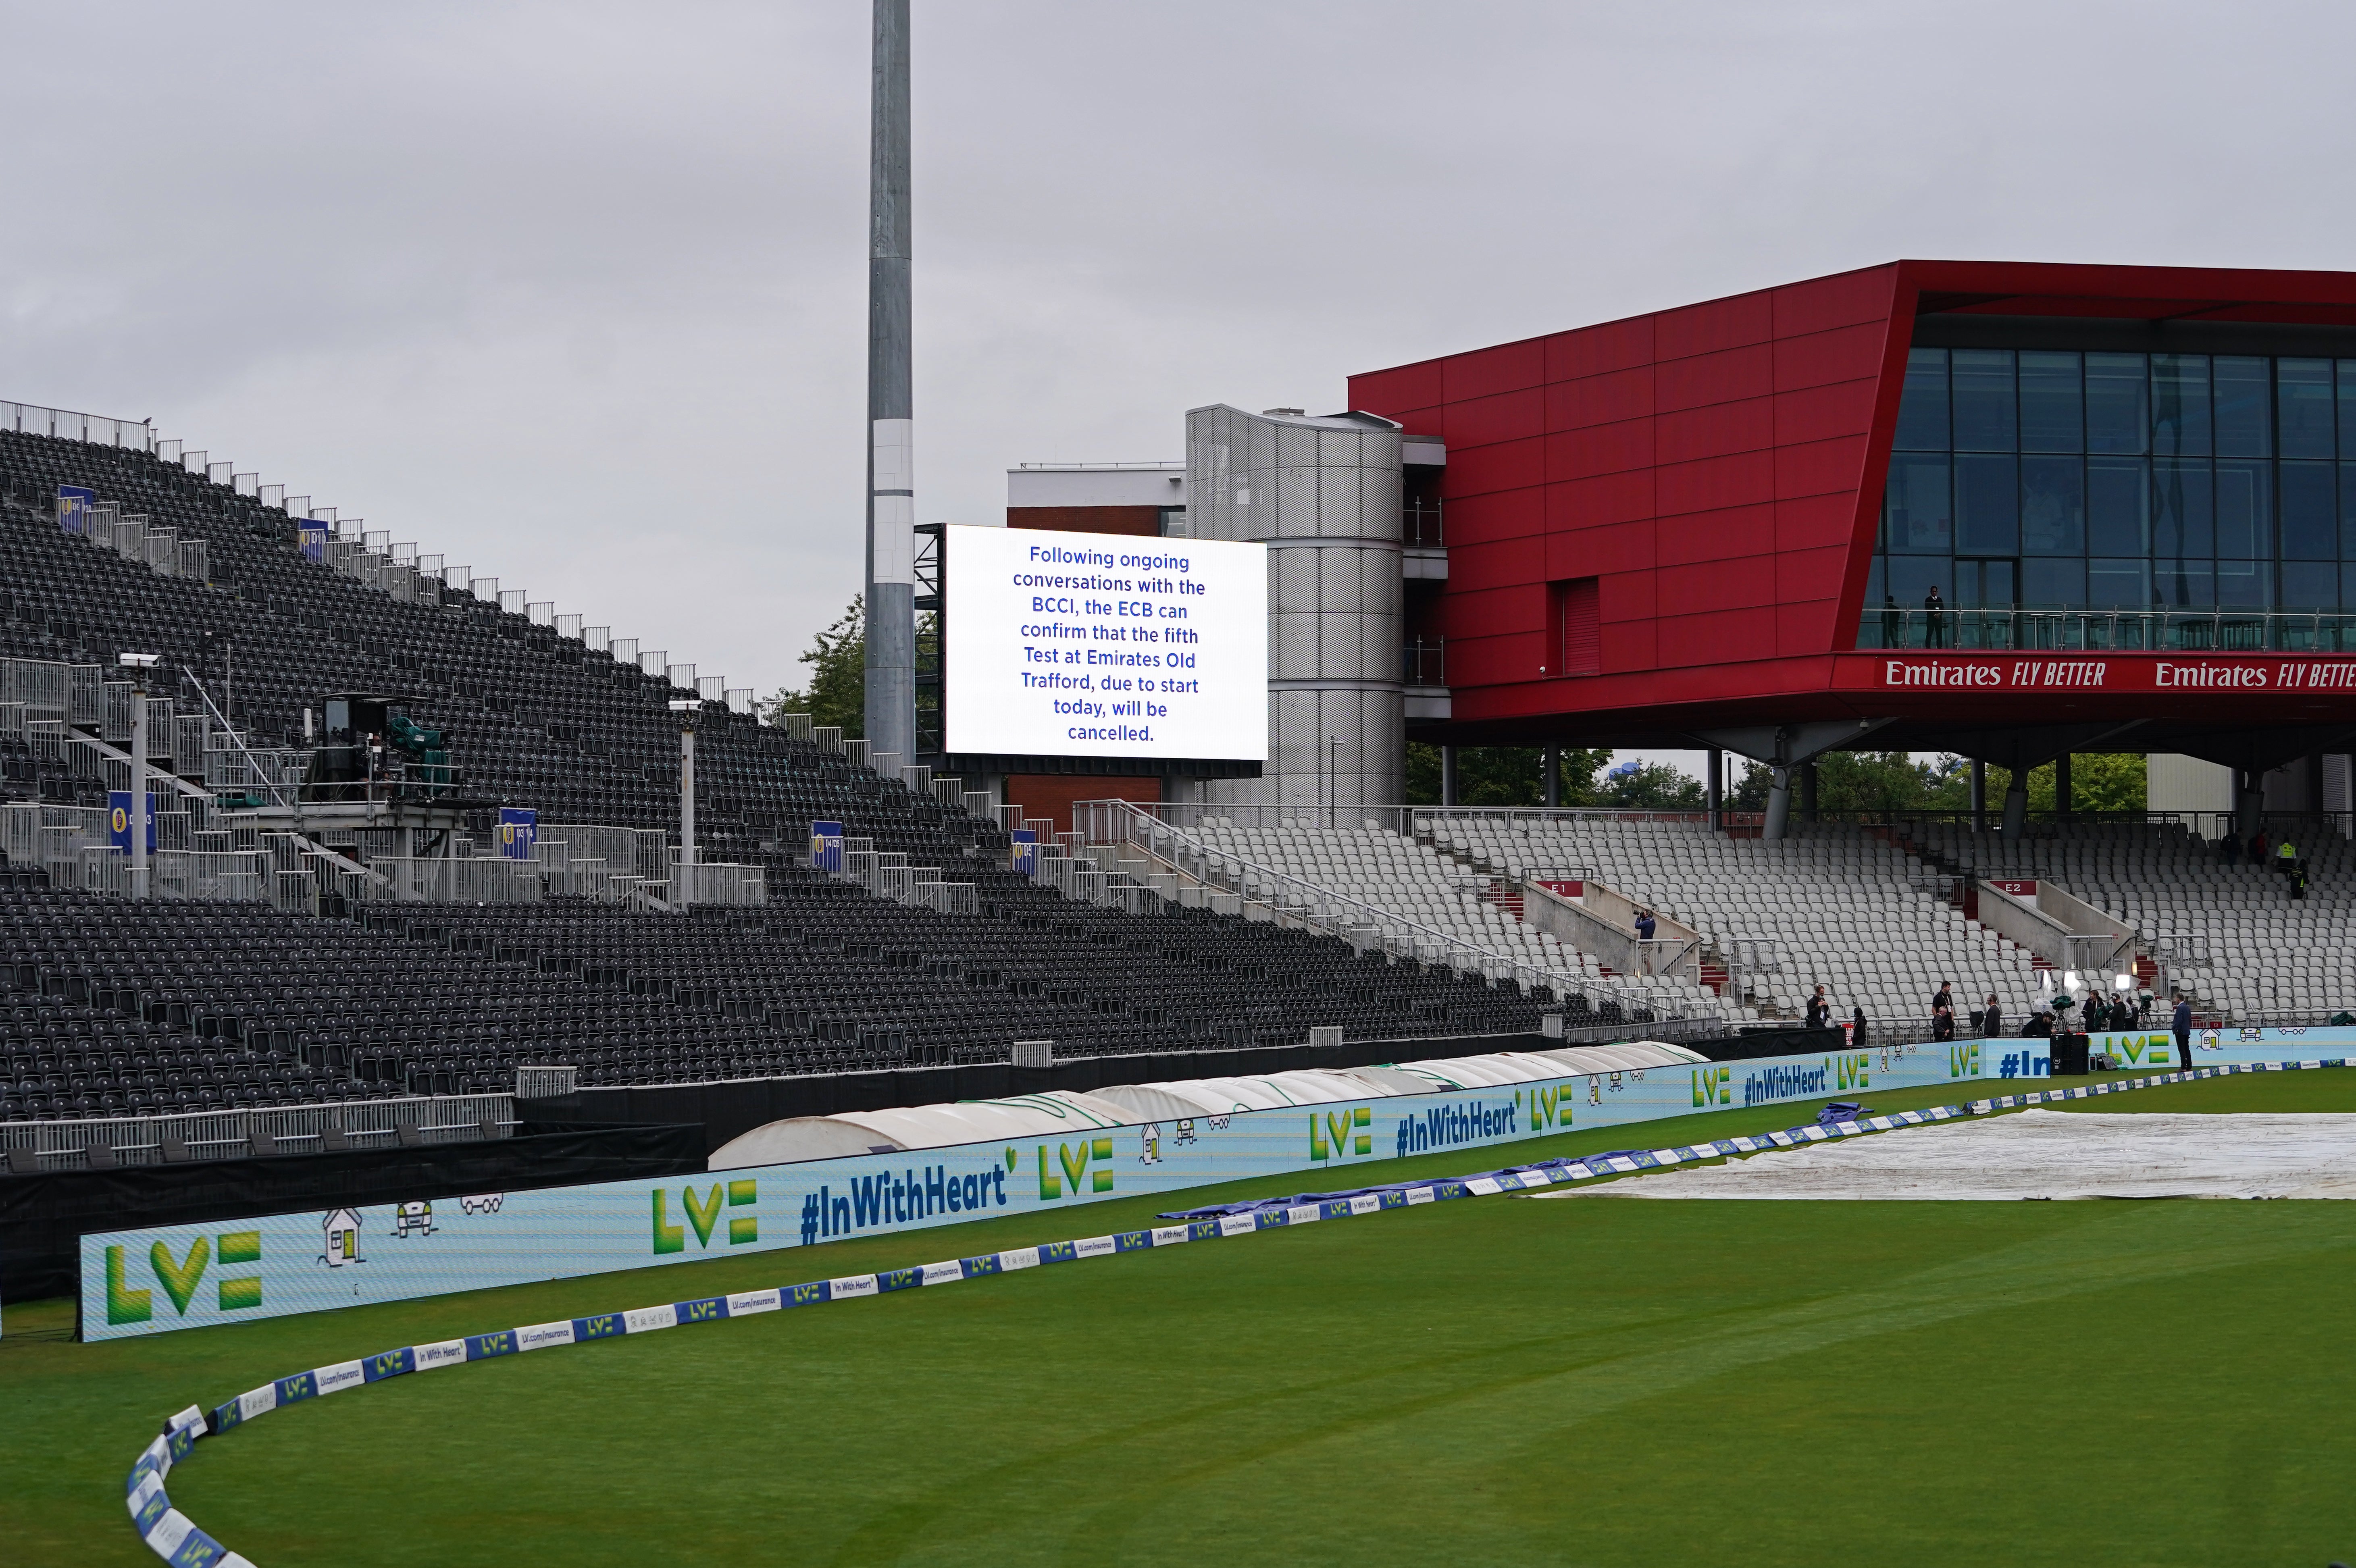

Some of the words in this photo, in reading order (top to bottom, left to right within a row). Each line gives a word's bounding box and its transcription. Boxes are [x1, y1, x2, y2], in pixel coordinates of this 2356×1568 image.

[1031, 547, 1113, 568] Following
[1120, 554, 1188, 572] ongoing
[1014, 574, 1131, 591] conversations
[1138, 578, 1172, 593] with
[1179, 579, 1205, 595] the
[1033, 597, 1078, 616] BCCI,
[1085, 599, 1111, 615] the
[1119, 601, 1153, 617] ECB
[1159, 607, 1186, 618] can
[1021, 623, 1086, 638] confirm
[1093, 625, 1126, 641] that
[1132, 627, 1158, 642] the
[1165, 628, 1197, 643] fifth
[1024, 647, 1058, 663] Test
[1065, 650, 1080, 663] at
[1088, 650, 1160, 667] Emirates
[1167, 653, 1195, 668] Old
[1022, 672, 1094, 692] Trafford,
[1101, 675, 1132, 690] due
[1138, 678, 1154, 691] to
[1161, 679, 1198, 693] start
[1887, 661, 2000, 685] Emirates
[2012, 663, 2041, 685] FLY
[2044, 663, 2105, 685] BETTER
[2156, 663, 2266, 686] Emirates
[2277, 664, 2306, 686] FLY
[1054, 699, 1105, 718] today,
[1112, 701, 1140, 715] will
[1147, 701, 1167, 717] be
[1068, 725, 1153, 741] cancelled.
[1745, 1065, 1825, 1107] #InWithHeart
[1397, 1102, 1515, 1158] #InWithHeart
[801, 1163, 1006, 1246] #InWithHeart
[1224, 1221, 1252, 1231] LV.com/insurance
[1078, 1242, 1111, 1252] LV.com/insurance
[924, 1267, 958, 1279] LV.com/insurance
[732, 1297, 776, 1310] LV.com/insurance
[522, 1329, 569, 1343] LV.com/insurance
[420, 1352, 426, 1362] In
[427, 1350, 441, 1361] With
[443, 1346, 461, 1359] Heart
[320, 1369, 360, 1386] LV.com/insurance
